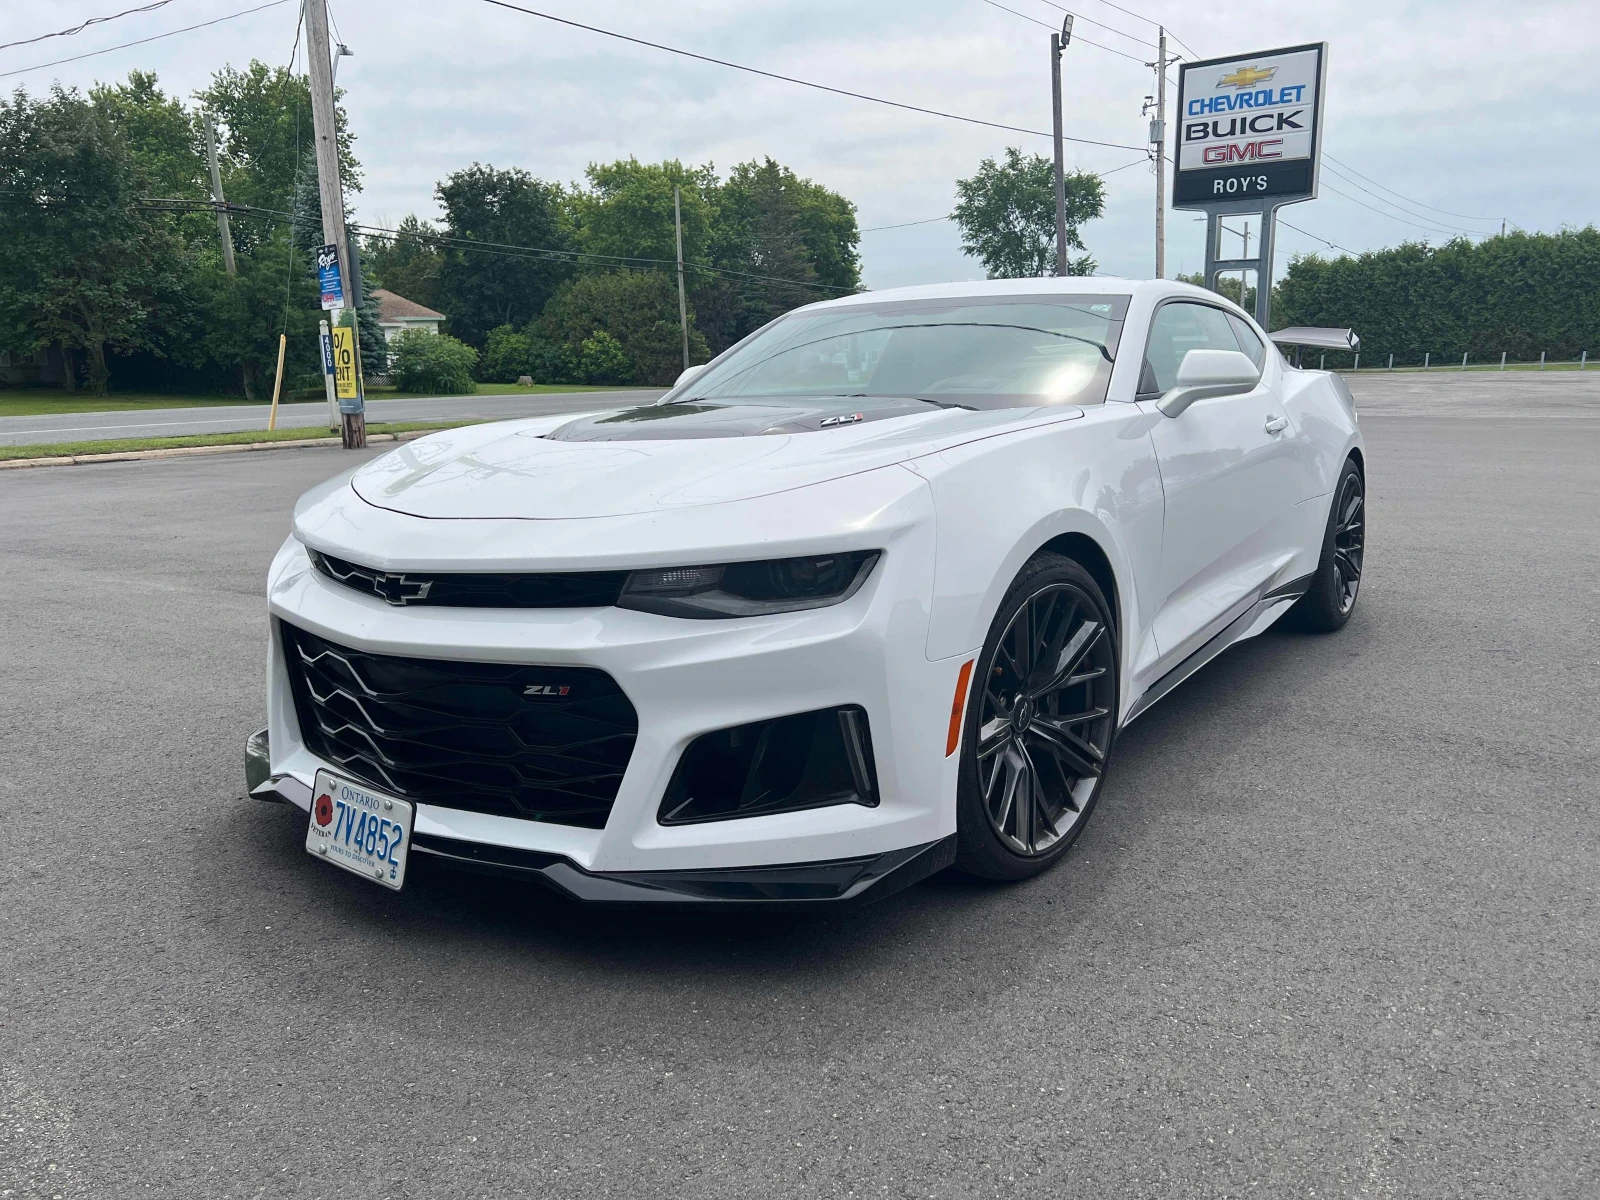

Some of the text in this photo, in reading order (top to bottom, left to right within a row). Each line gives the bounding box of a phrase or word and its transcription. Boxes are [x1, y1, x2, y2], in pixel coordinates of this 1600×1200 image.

[1188, 84, 1306, 116] CHEVROLET
[1185, 109, 1305, 141] BUICK
[1202, 138, 1283, 165] GMC
[1213, 175, 1268, 194] ROY'S
[324, 336, 333, 367] 4000
[820, 412, 863, 428] ZL1
[523, 685, 570, 696] ZL1
[341, 786, 380, 811] ONTARIO
[310, 822, 332, 838] VETERAN
[333, 799, 403, 867] 7V4852
[330, 844, 376, 868] YOURS TO DISCOVER
